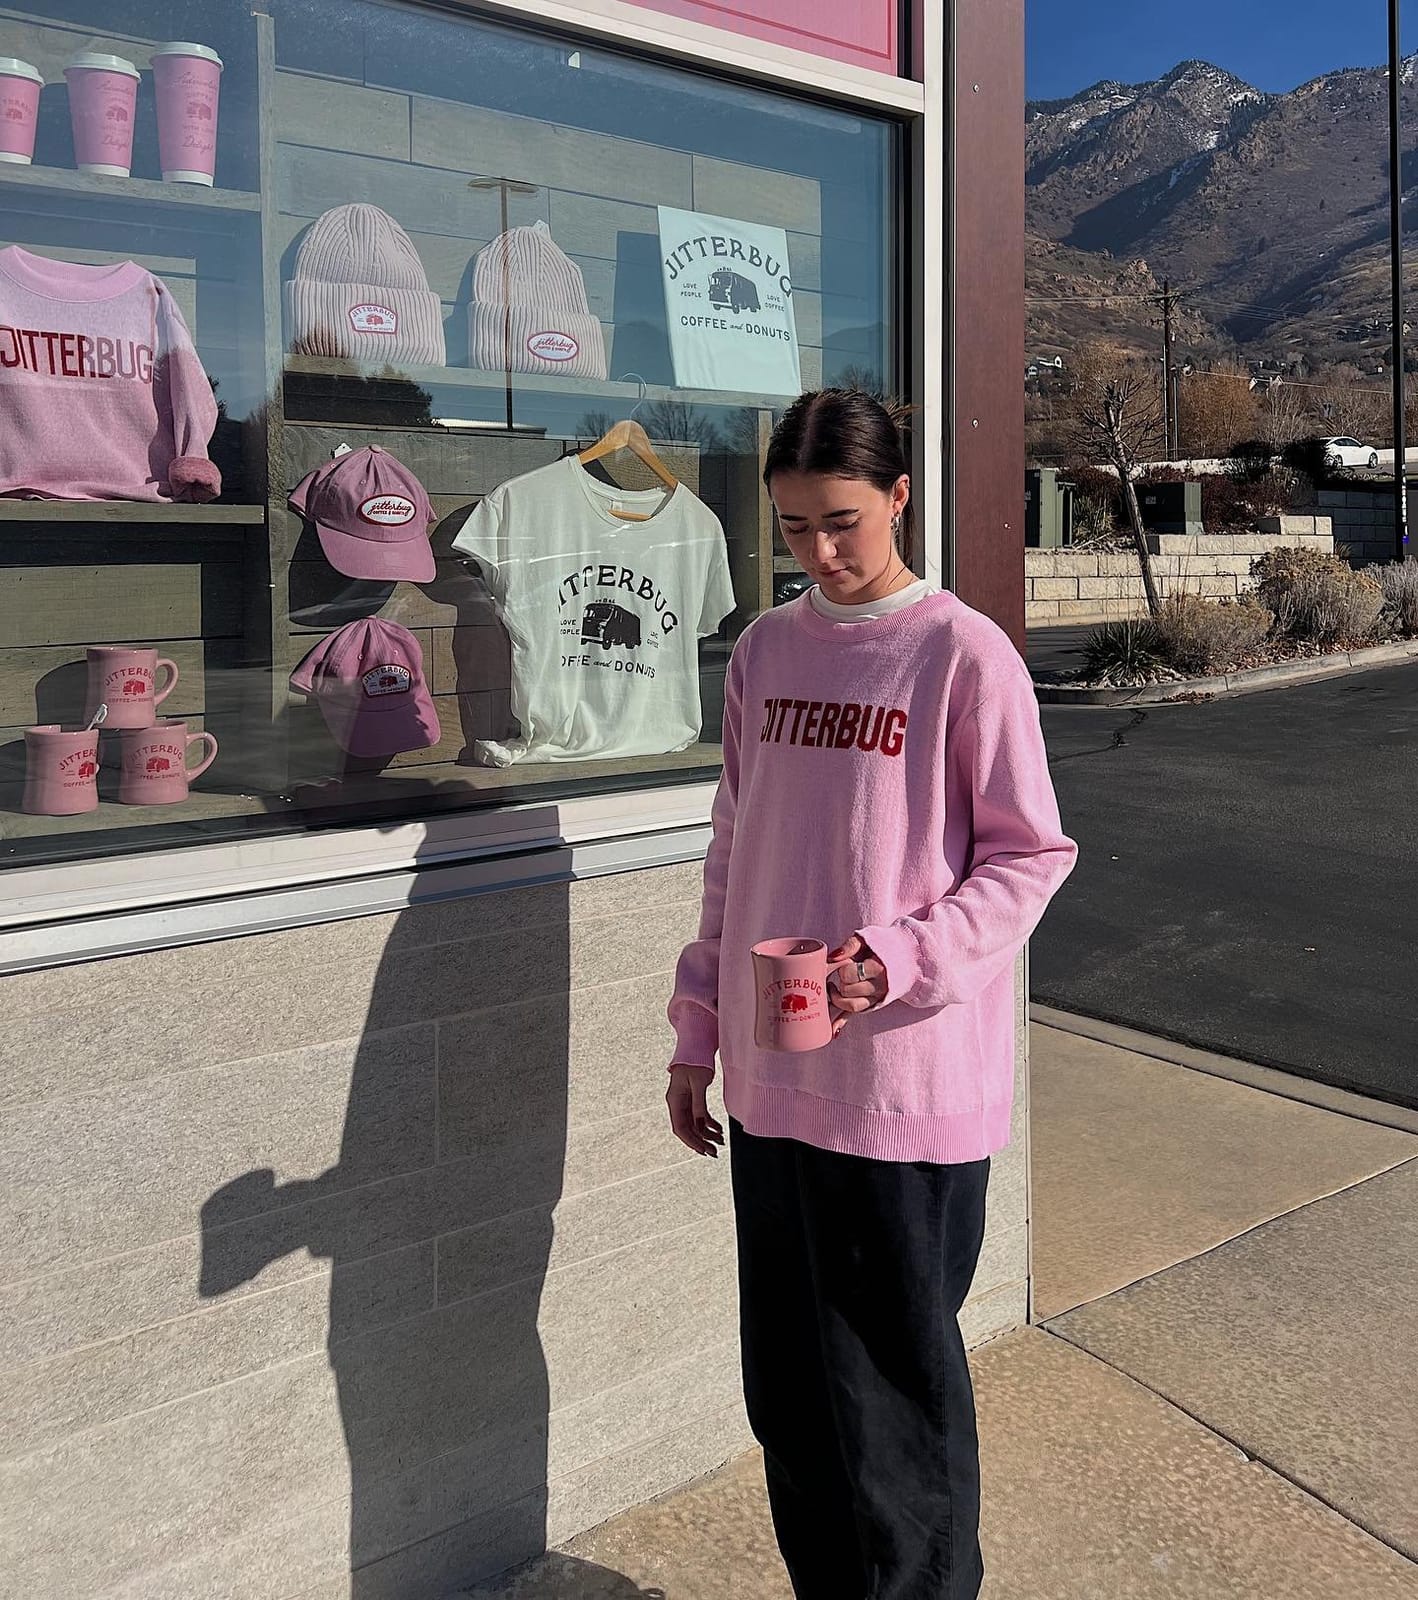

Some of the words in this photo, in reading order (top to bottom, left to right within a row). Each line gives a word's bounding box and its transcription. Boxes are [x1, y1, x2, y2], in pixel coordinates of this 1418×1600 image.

[665, 236, 792, 298] JITTERBUG
[767, 294, 780, 303] LOVE
[680, 315, 728, 330] COFFEE
[745, 323, 791, 341] DONUTS
[0, 324, 153, 385] JITTERBUG
[367, 500, 412, 517] jitterbug
[558, 565, 678, 635] ITTERBUG
[593, 660, 613, 668] and
[104, 667, 154, 686] JITTERBU
[760, 698, 908, 757] JITTERBUG
[763, 978, 822, 1000] JITTERBUG
